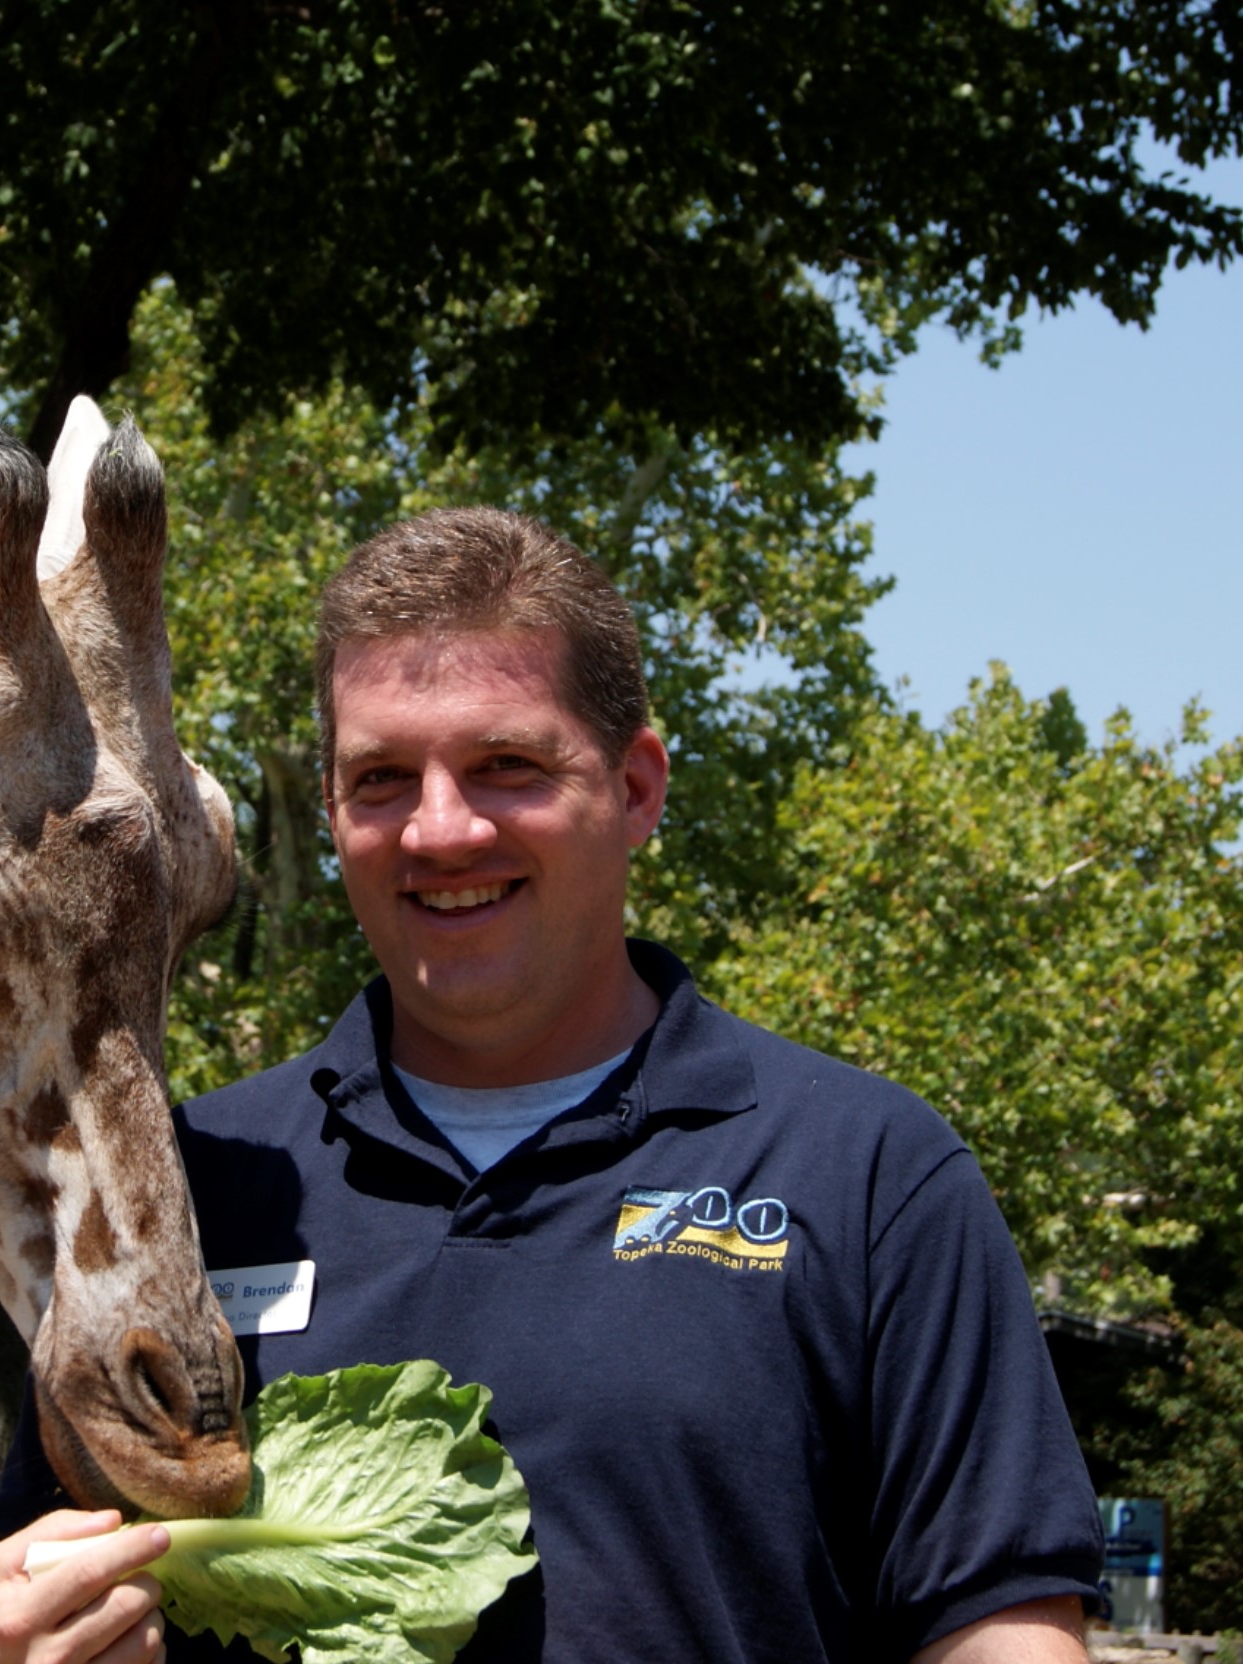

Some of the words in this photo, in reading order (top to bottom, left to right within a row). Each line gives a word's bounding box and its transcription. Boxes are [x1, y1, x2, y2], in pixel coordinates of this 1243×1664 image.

[613, 1243, 663, 1261] Topeka
[666, 1241, 743, 1269] Zoological
[749, 1258, 783, 1271] Park
